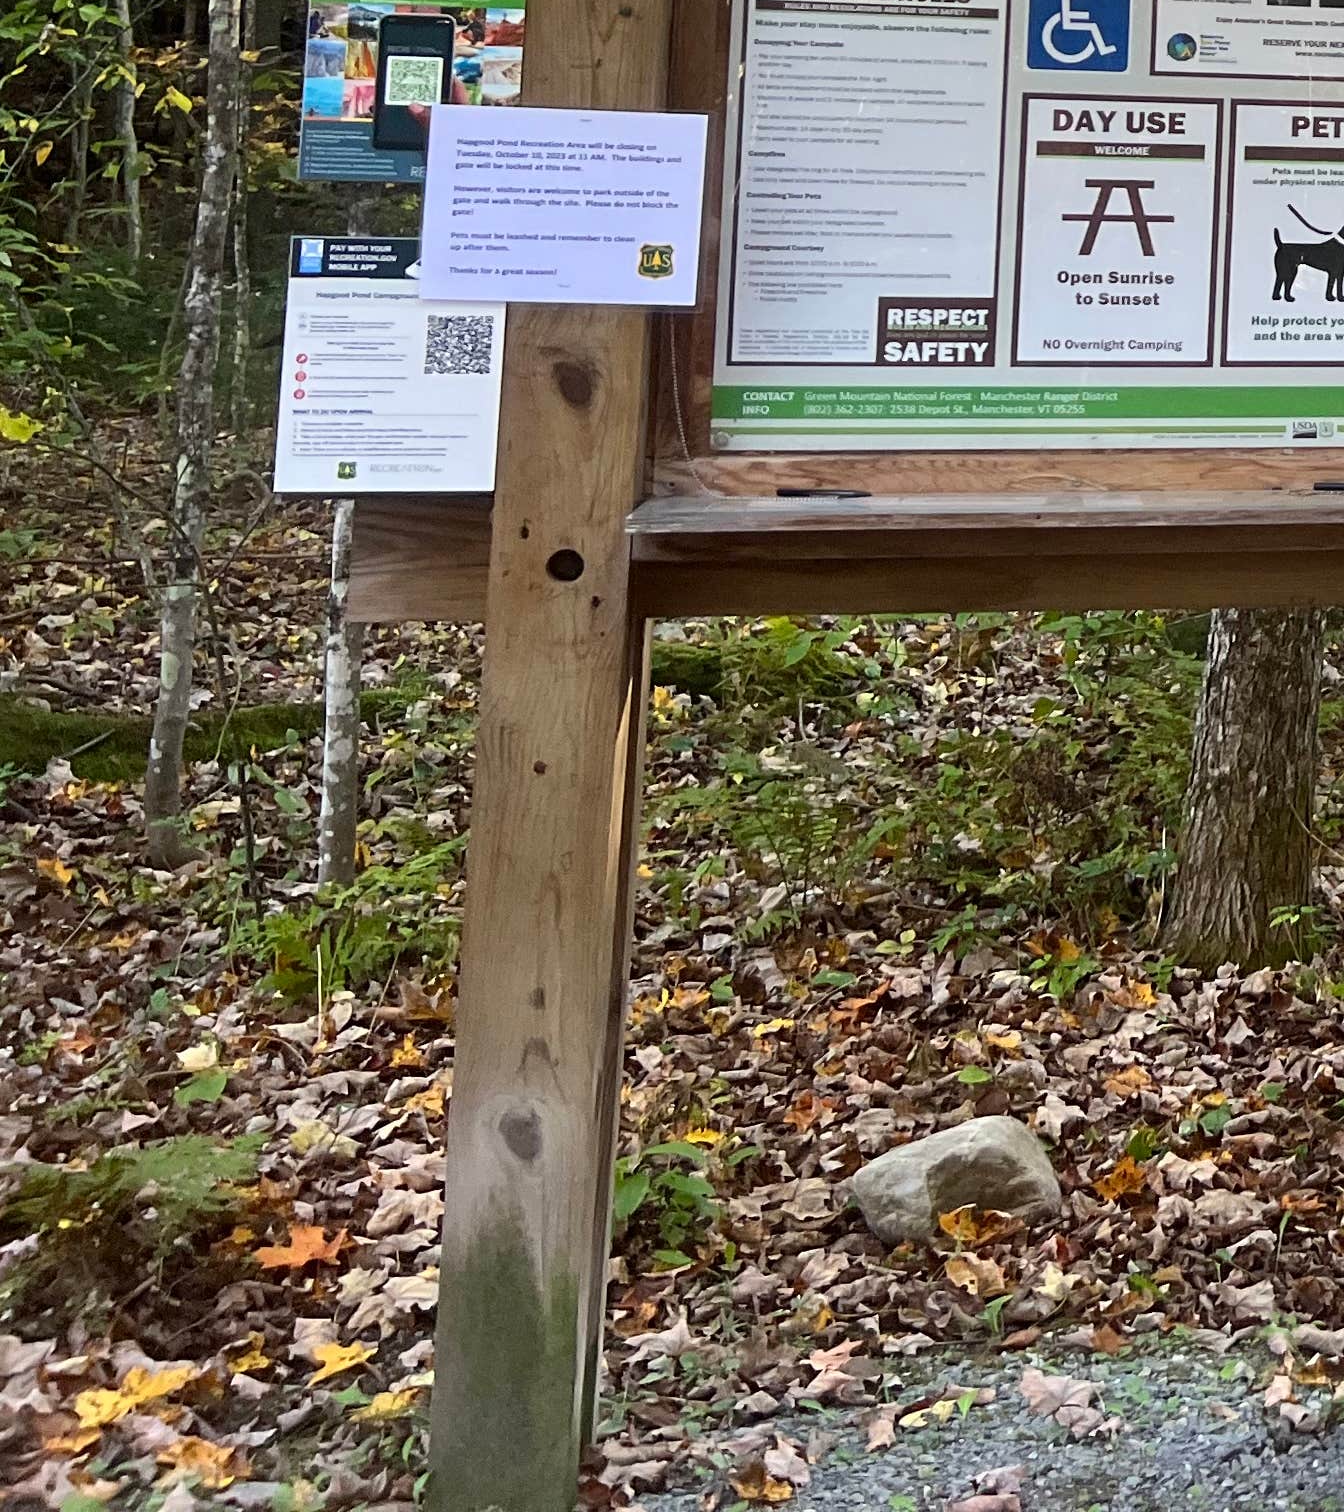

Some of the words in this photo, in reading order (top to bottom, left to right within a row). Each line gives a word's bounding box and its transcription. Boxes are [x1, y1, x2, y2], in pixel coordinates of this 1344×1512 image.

[1304, 39, 1327, 49] YOUR
[1052, 108, 1118, 133] DAY
[1125, 111, 1187, 135] USE
[1093, 145, 1151, 157] WELCOME
[1271, 167, 1291, 177] Pets
[1293, 168, 1316, 177] must
[1317, 168, 1328, 178] be
[1252, 177, 1278, 187] under
[1279, 177, 1315, 189] physical
[330, 244, 346, 253] PAY
[347, 244, 368, 254] WITH
[370, 245, 392, 254] YOUR
[329, 253, 398, 263] RECREATION.GOV
[328, 263, 359, 272] MOBILE
[360, 263, 378, 272] APP
[1056, 270, 1103, 287] Open
[1107, 270, 1175, 286] Sunrise
[1075, 291, 1094, 306] to
[1098, 292, 1161, 307] Sunset
[887, 308, 990, 327] RESPECT
[1251, 314, 1281, 329] Help
[1283, 315, 1328, 329] protect
[1253, 330, 1276, 342] and
[1279, 330, 1302, 342] the
[1303, 332, 1332, 342] area
[1041, 338, 1061, 351] NO
[1063, 338, 1125, 352] Overnight
[1127, 338, 1184, 353] Camping
[882, 341, 990, 363] SAFETY
[742, 390, 796, 402] CONTACT
[804, 391, 838, 402] Green
[839, 391, 892, 402] Mountain
[893, 391, 938, 402] National
[939, 391, 973, 402] Forest
[979, 391, 1041, 402] Manchester
[1043, 391, 1081, 404] Ranger
[1082, 391, 1119, 402] District
[742, 405, 770, 415] INFO
[918, 404, 951, 416] Depot
[971, 404, 1035, 416] Manchester,
[1037, 405, 1053, 415] VT
[1292, 421, 1318, 431] USDA
